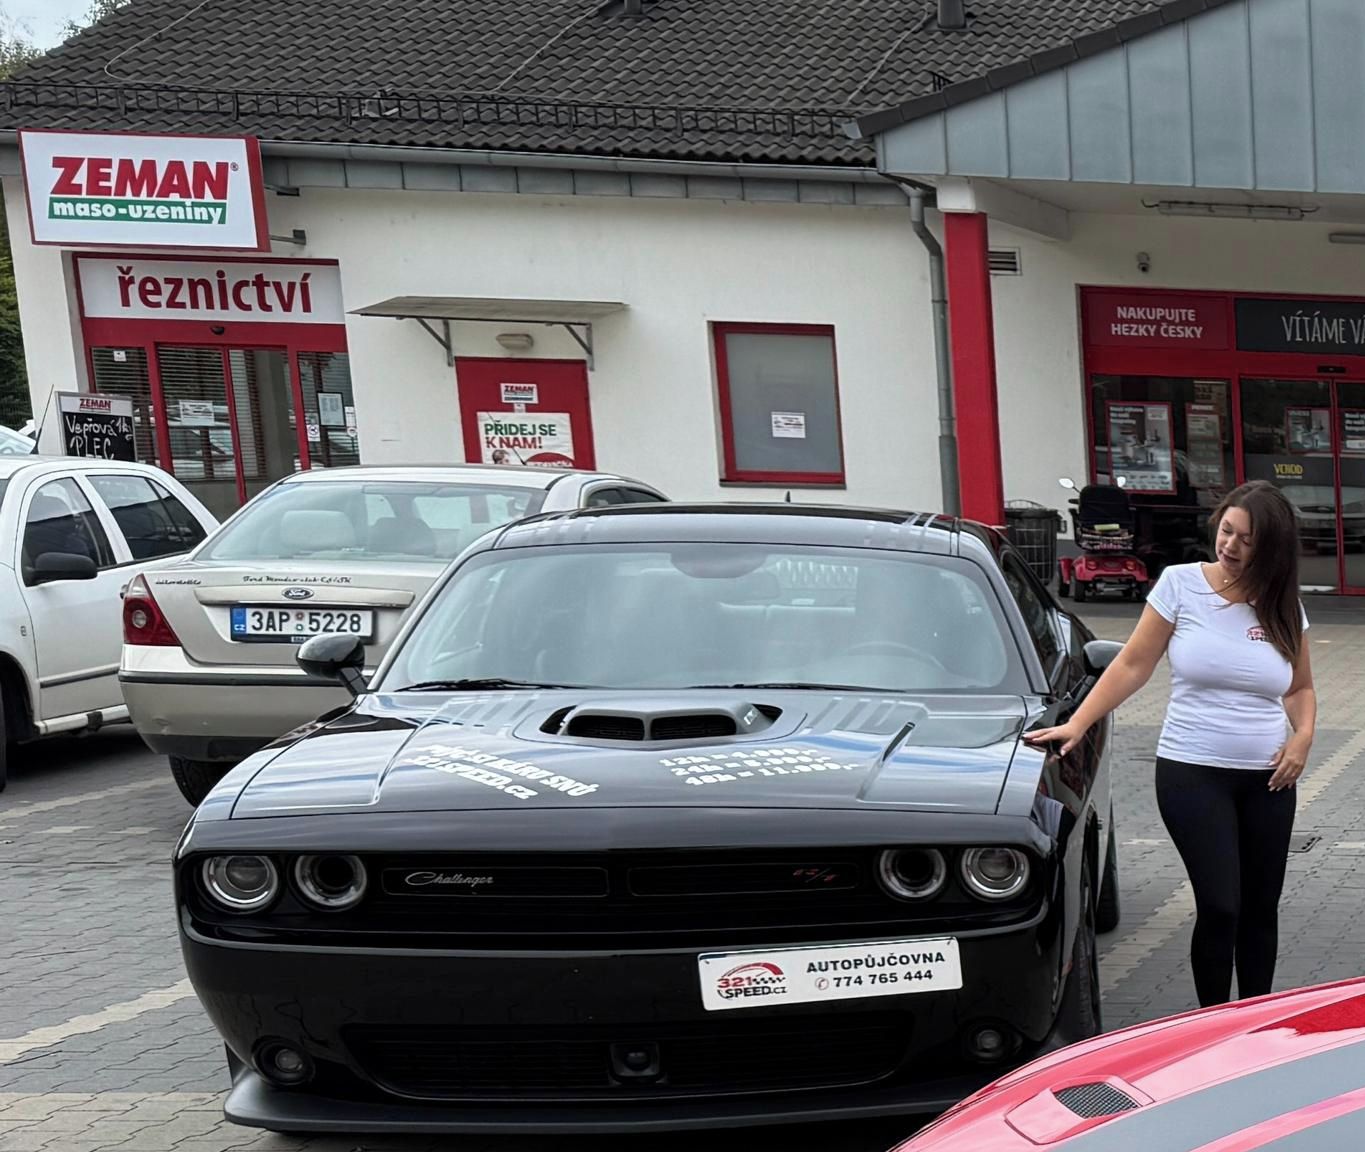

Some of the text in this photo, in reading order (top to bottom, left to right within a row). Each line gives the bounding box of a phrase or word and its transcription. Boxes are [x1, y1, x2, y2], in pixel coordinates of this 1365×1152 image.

[50, 156, 230, 201] ZEMAN
[53, 201, 223, 224] maso-uzeniny
[117, 265, 312, 313] řeznictví
[1116, 306, 1197, 323] NAKUPUJTE
[1111, 321, 1203, 338] HEZKY ČESKY
[1281, 310, 1347, 345] VÍTÁME
[80, 399, 111, 409] ZEMAN
[484, 420, 557, 436] PŘIDEJ SE
[485, 436, 498, 449] K
[251, 610, 290, 632] 3AP
[308, 611, 362, 633] 5228
[404, 870, 495, 888] Challenger
[806, 951, 946, 974] AUTOPŮJČOVNA
[717, 976, 752, 988] 321
[833, 968, 934, 988] 774 765 444
